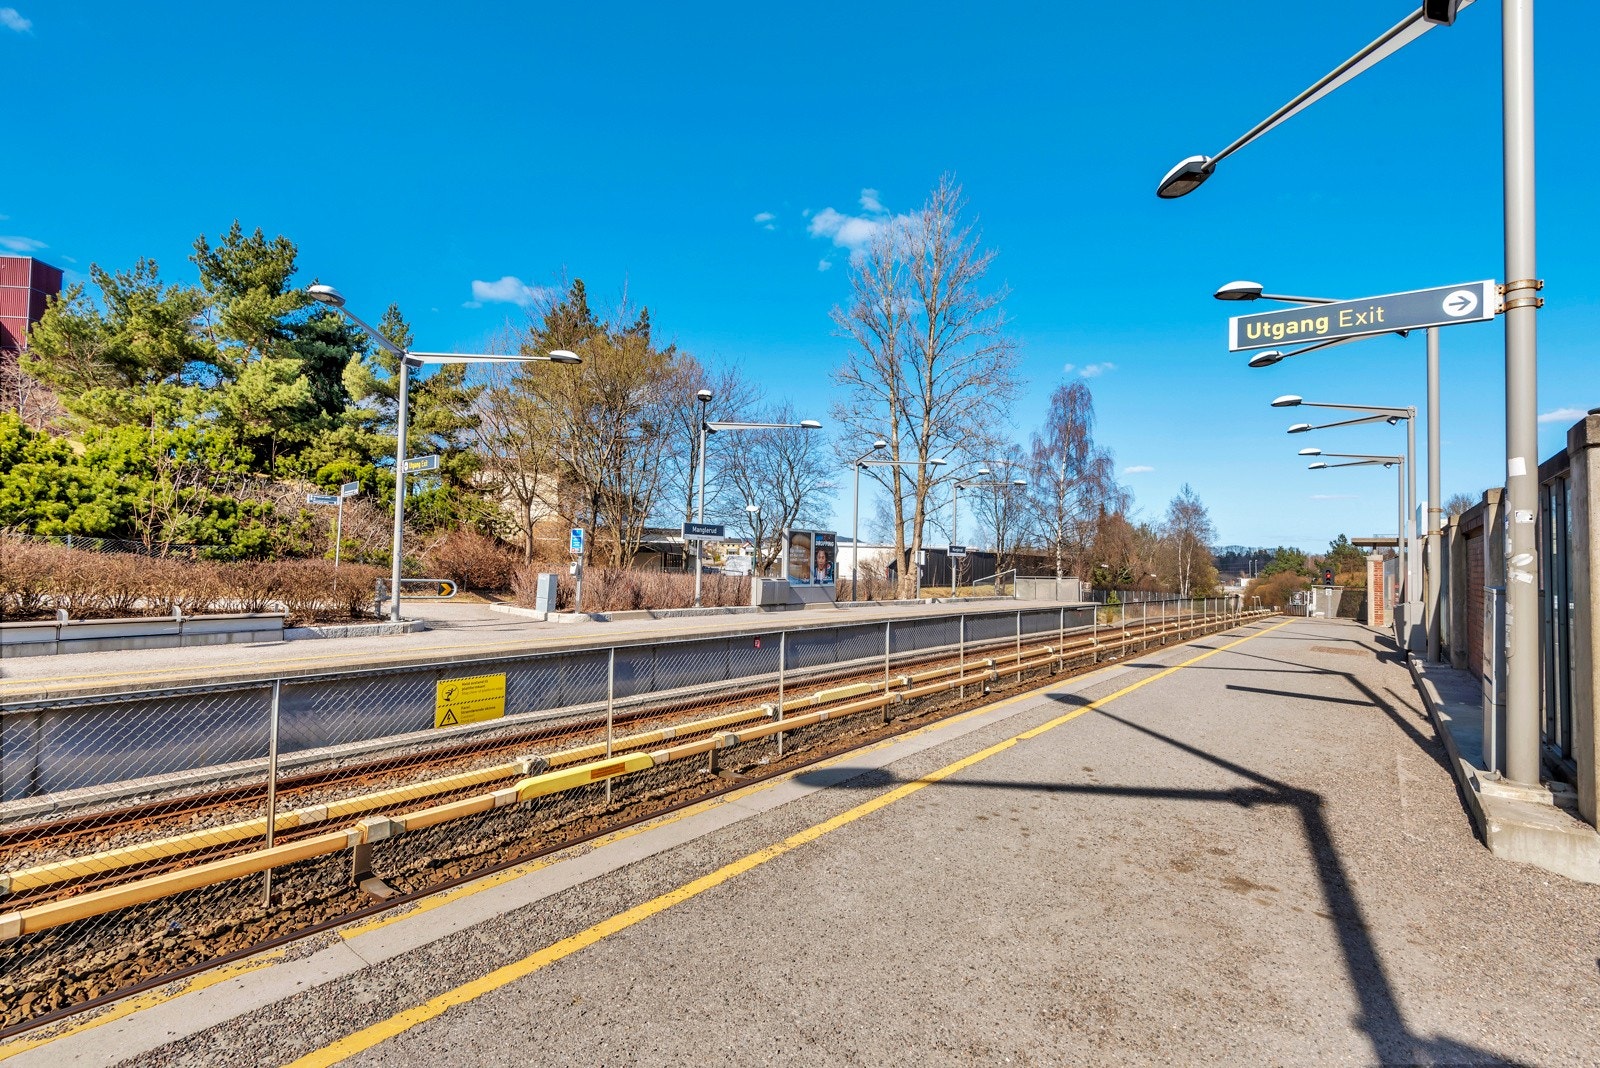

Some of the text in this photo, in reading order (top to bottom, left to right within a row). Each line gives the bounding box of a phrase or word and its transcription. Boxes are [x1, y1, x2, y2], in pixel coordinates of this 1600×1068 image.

[1246, 306, 1385, 340] Utgang Exit
[692, 526, 718, 535] Manglerud
